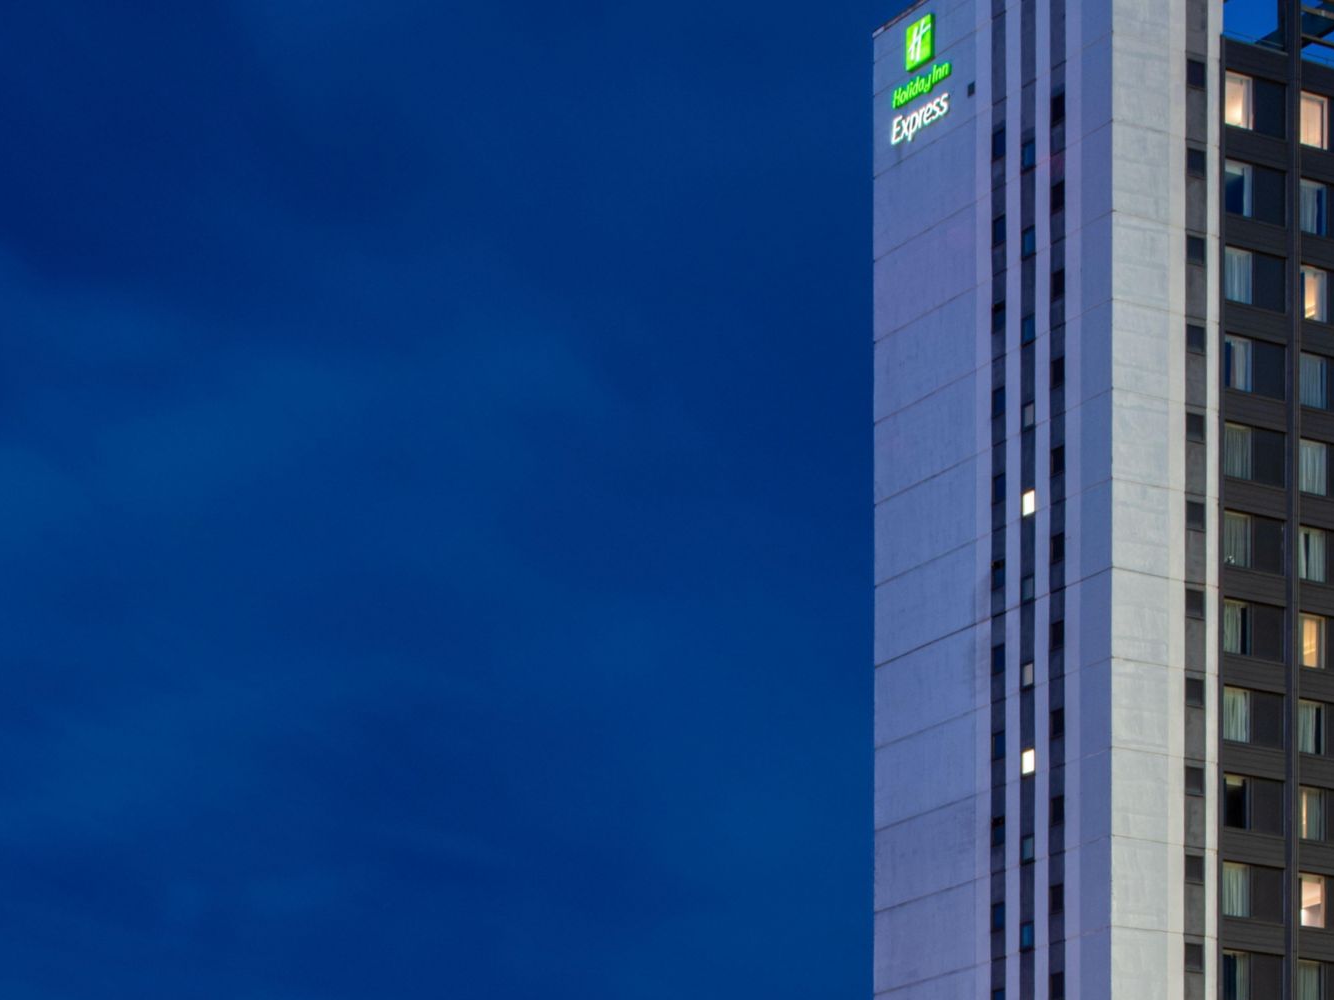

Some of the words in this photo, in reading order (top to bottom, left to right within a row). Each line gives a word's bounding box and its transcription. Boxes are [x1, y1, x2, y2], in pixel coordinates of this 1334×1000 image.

[892, 74, 932, 109] Holiday
[932, 62, 950, 84] Inn
[891, 93, 948, 145] Express
